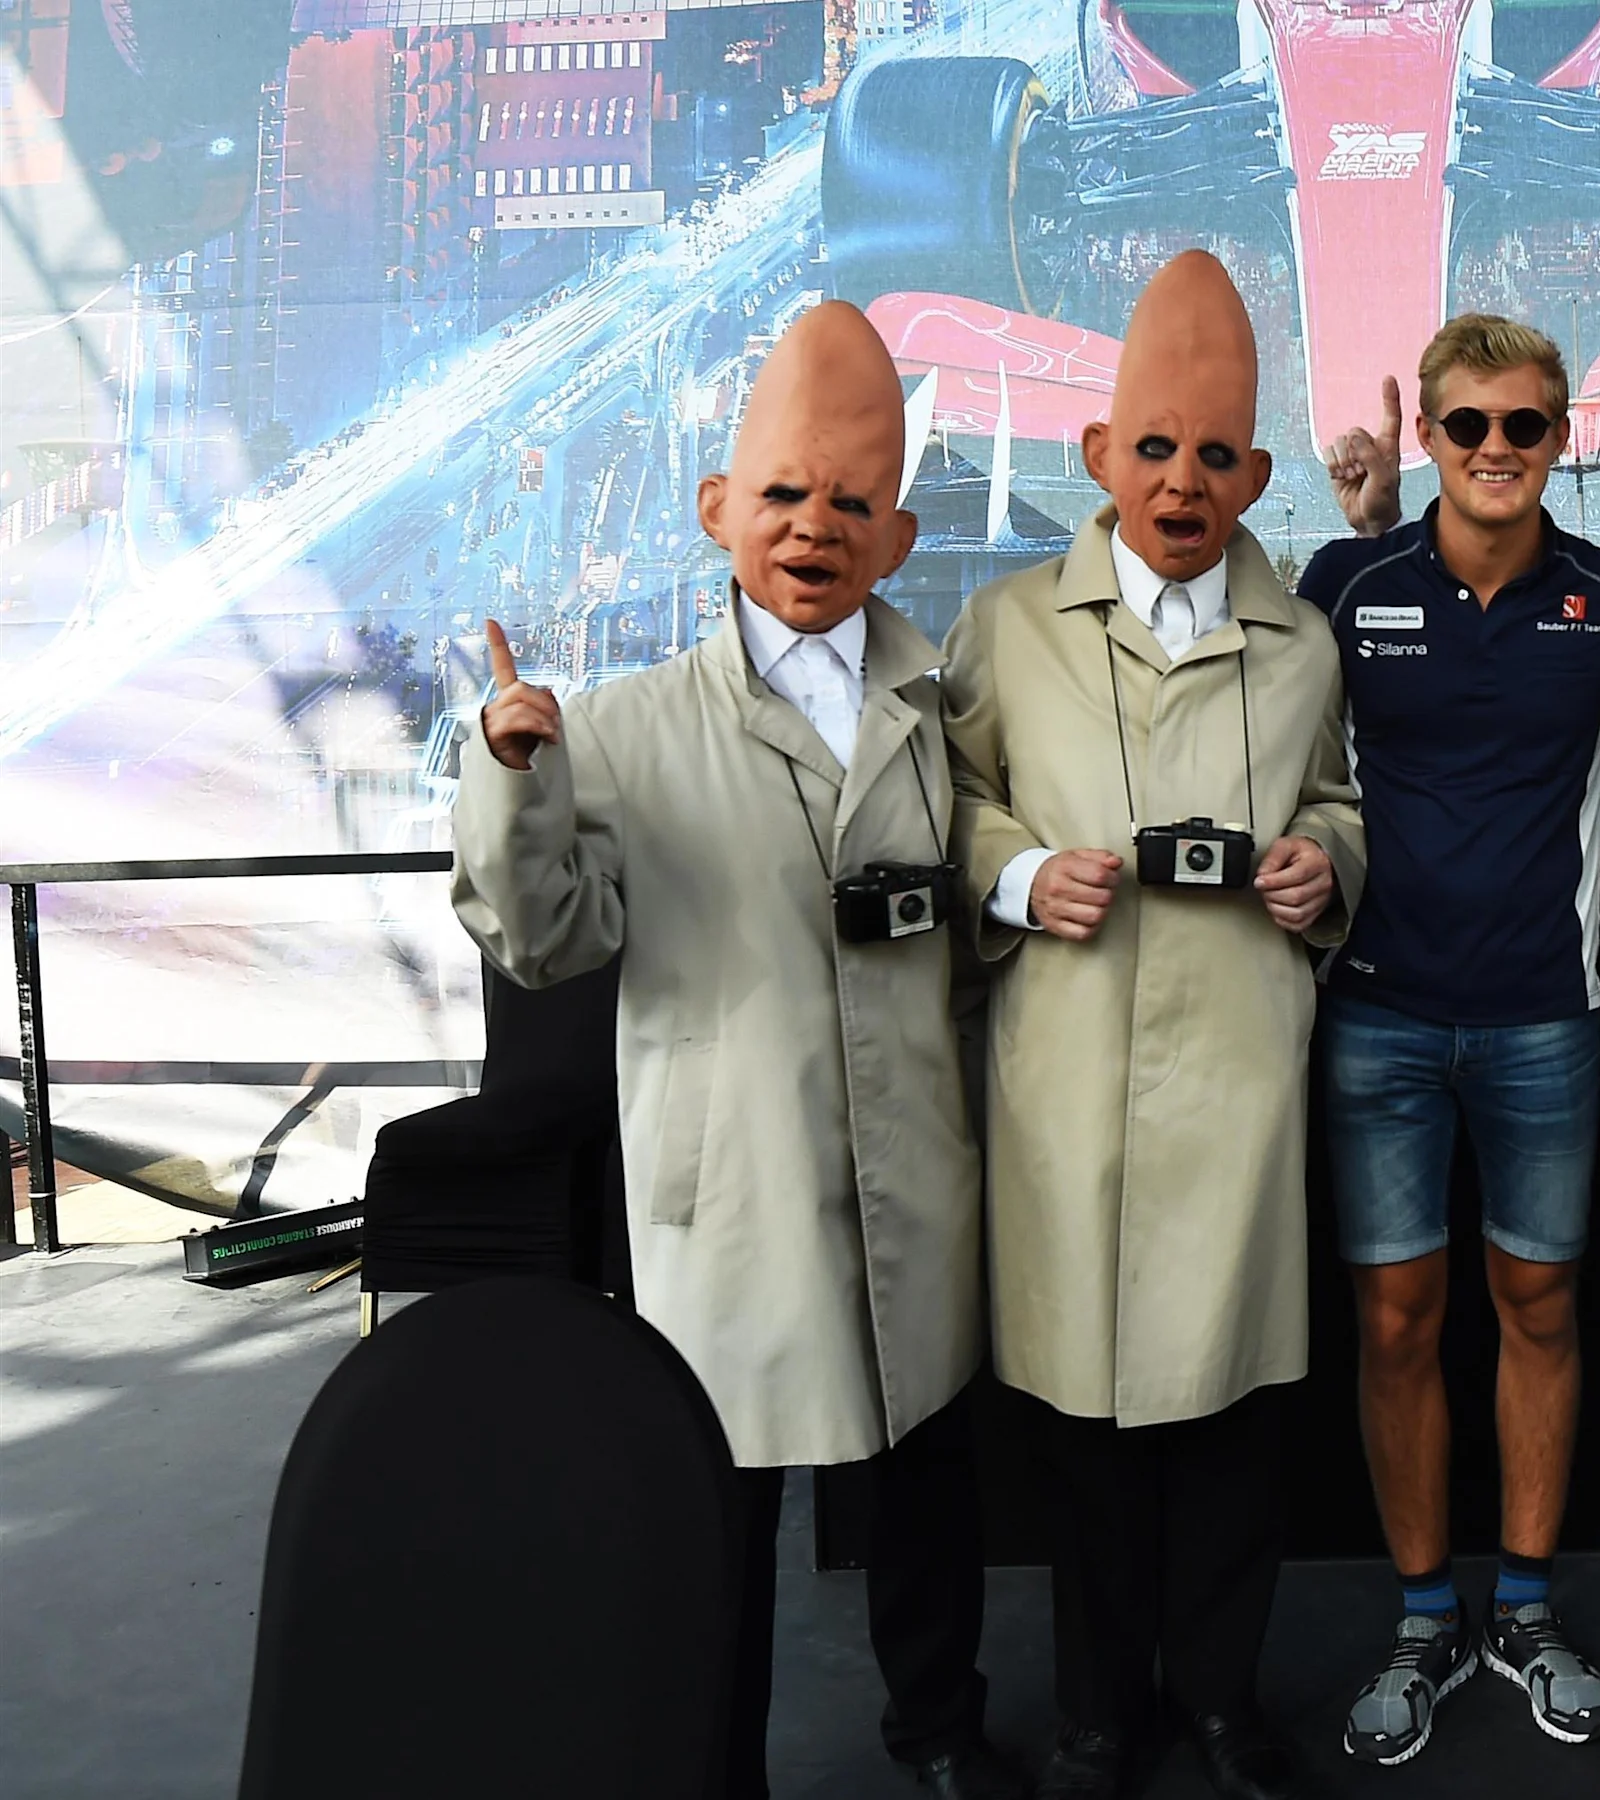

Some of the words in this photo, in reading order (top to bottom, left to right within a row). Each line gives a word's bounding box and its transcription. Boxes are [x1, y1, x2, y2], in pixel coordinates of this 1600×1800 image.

[1328, 132, 1427, 155] YAS
[1324, 154, 1420, 164] MARINA
[1320, 163, 1420, 174] CIRCUIT
[1536, 621, 1568, 632] Sauber
[1570, 623, 1582, 632] F1
[1377, 642, 1428, 656] Silanna
[277, 1227, 315, 1245] STAGING
